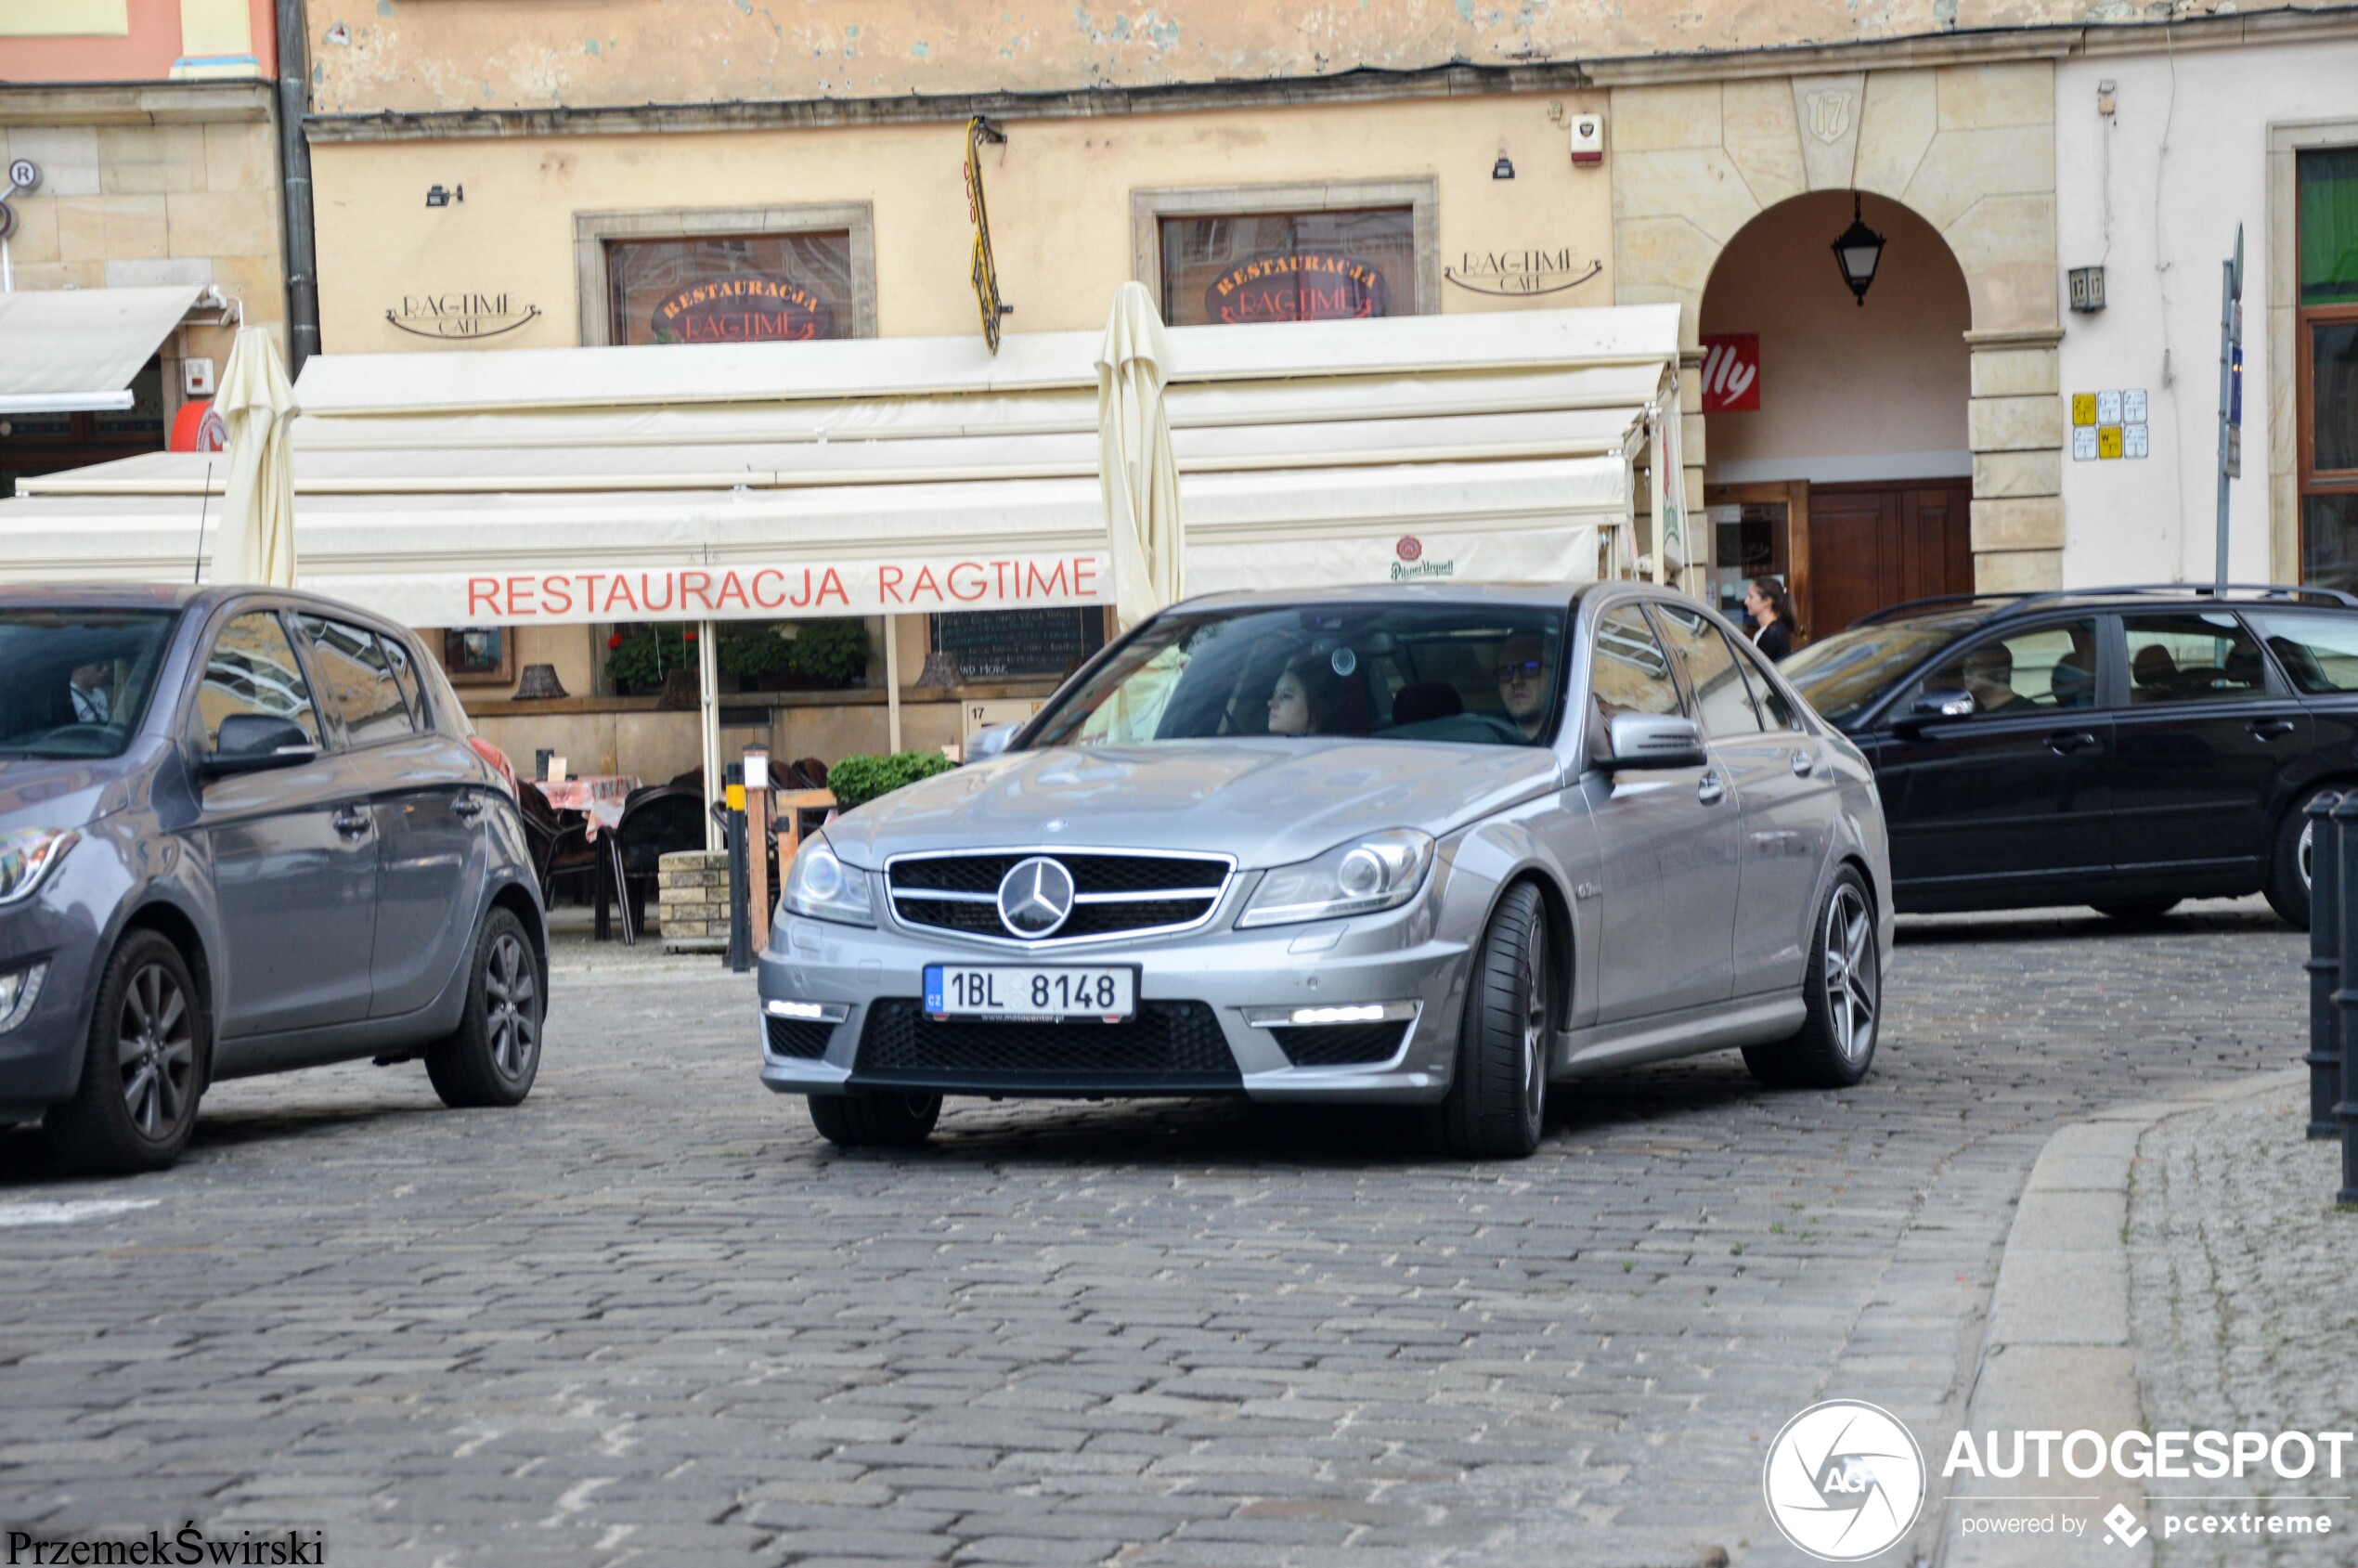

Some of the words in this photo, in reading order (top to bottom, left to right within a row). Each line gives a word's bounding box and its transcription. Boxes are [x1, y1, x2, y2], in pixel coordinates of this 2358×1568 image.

[1817, 94, 1845, 136] 17
[17, 166, 29, 181] R
[1217, 255, 1376, 297] RESTAURACJA
[1463, 246, 1577, 276] RAGTIME
[663, 280, 818, 320] RESTAURACJA
[1239, 285, 1354, 316] RAGTIME
[2074, 279, 2084, 296] 17
[2092, 278, 2101, 295] 17
[403, 292, 514, 318] RAGTIME
[685, 310, 797, 340] RAGTIME
[1701, 343, 1756, 406] lly
[468, 567, 850, 617] RESTAURACJA
[878, 557, 1097, 604] RAGTIME
[979, 664, 1008, 675] MORE
[971, 707, 985, 720] 17
[928, 994, 941, 1006] CZ
[952, 973, 1004, 1007] 1BL
[1031, 975, 1115, 1008] 8148
